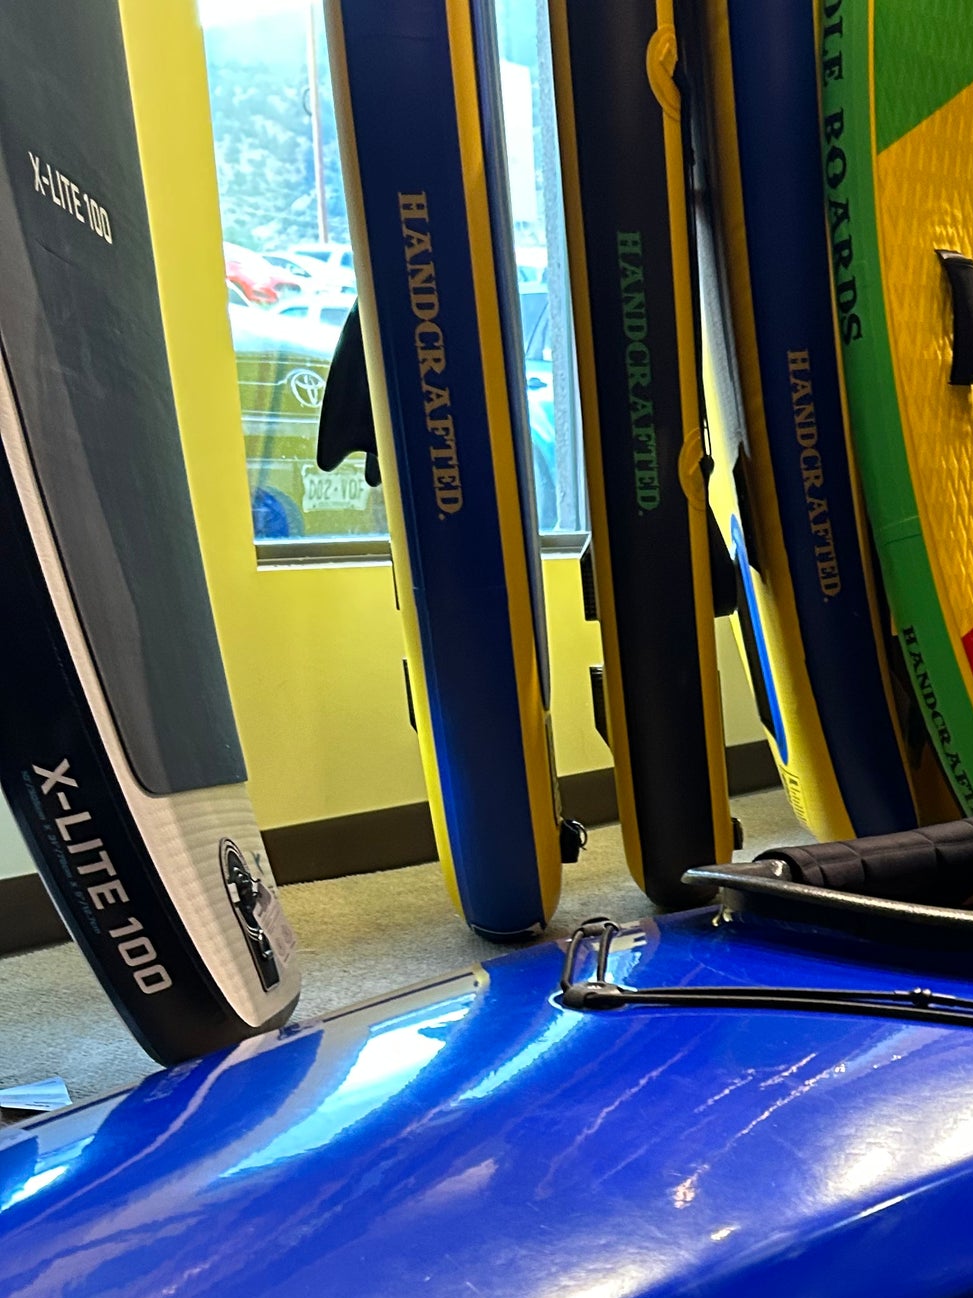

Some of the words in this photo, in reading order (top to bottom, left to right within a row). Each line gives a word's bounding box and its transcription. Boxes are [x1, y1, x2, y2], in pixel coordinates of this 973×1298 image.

[28, 151, 85, 223] X-LITE
[83, 193, 113, 245] 100
[824, 107, 863, 346] BOARDS
[398, 191, 464, 521] HANDCRAFTED.
[617, 231, 661, 516] HANDCRAFTED.
[32, 758, 130, 910] X-LITE
[108, 916, 174, 995] 100
